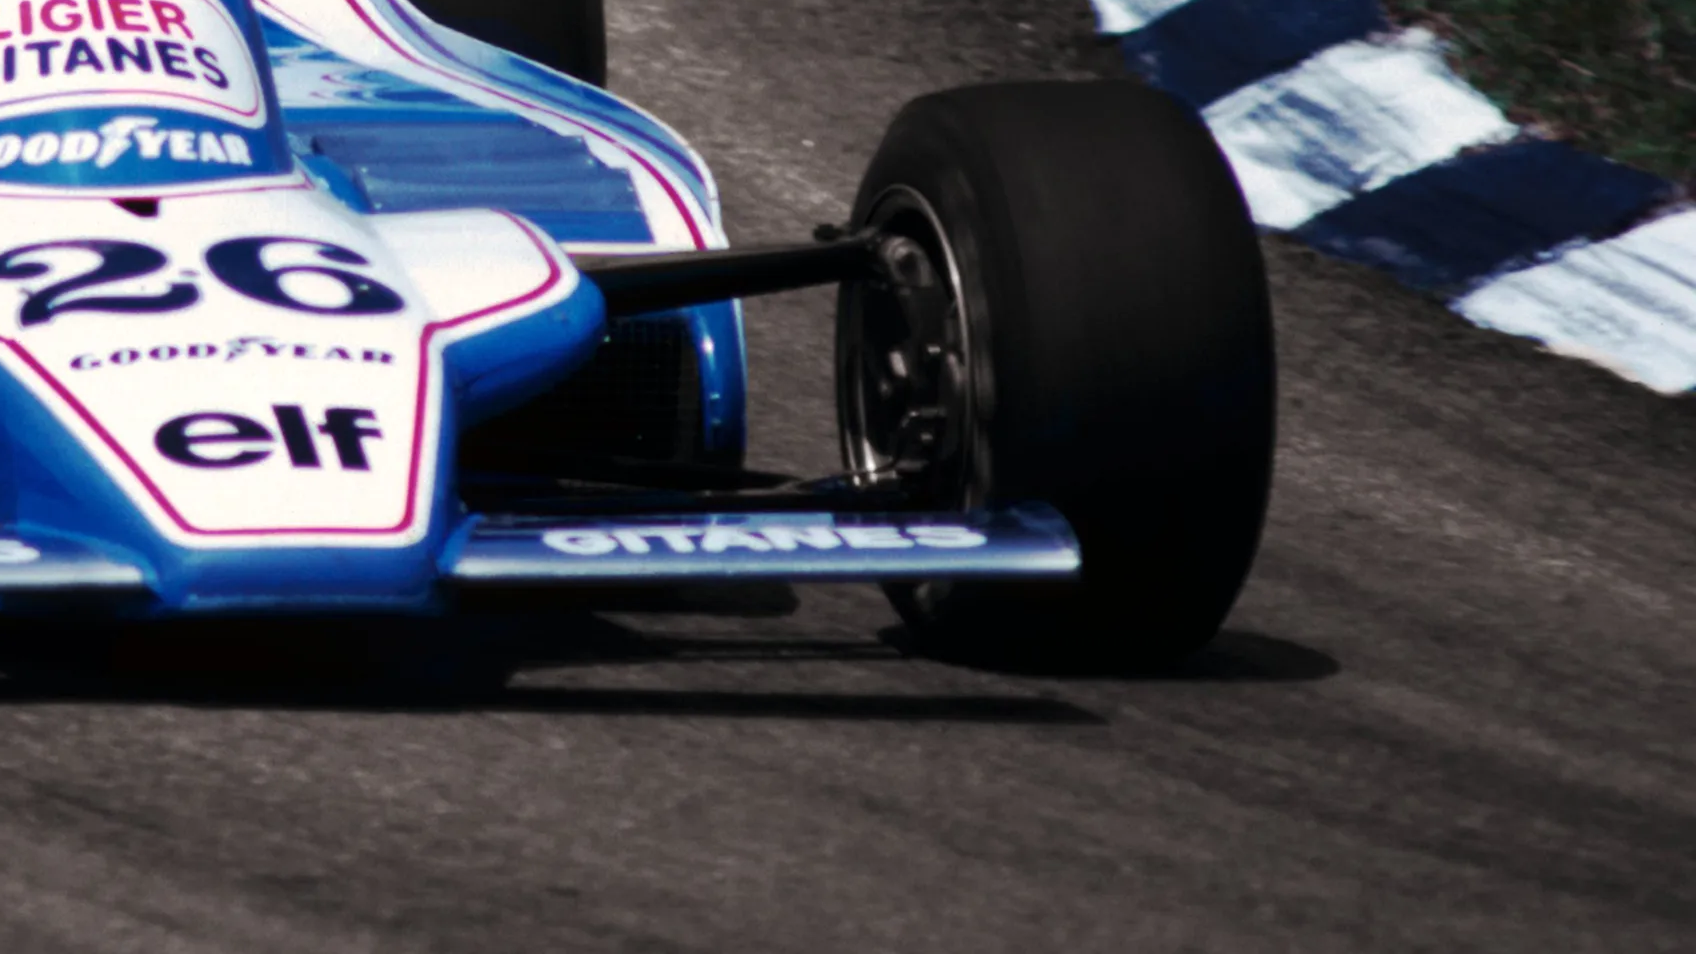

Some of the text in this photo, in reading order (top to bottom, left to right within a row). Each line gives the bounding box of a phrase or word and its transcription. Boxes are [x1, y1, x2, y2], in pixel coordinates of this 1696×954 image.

[70, 337, 395, 370] GOODYEAR
[153, 404, 384, 471] elf
[542, 525, 987, 554] GITANES
